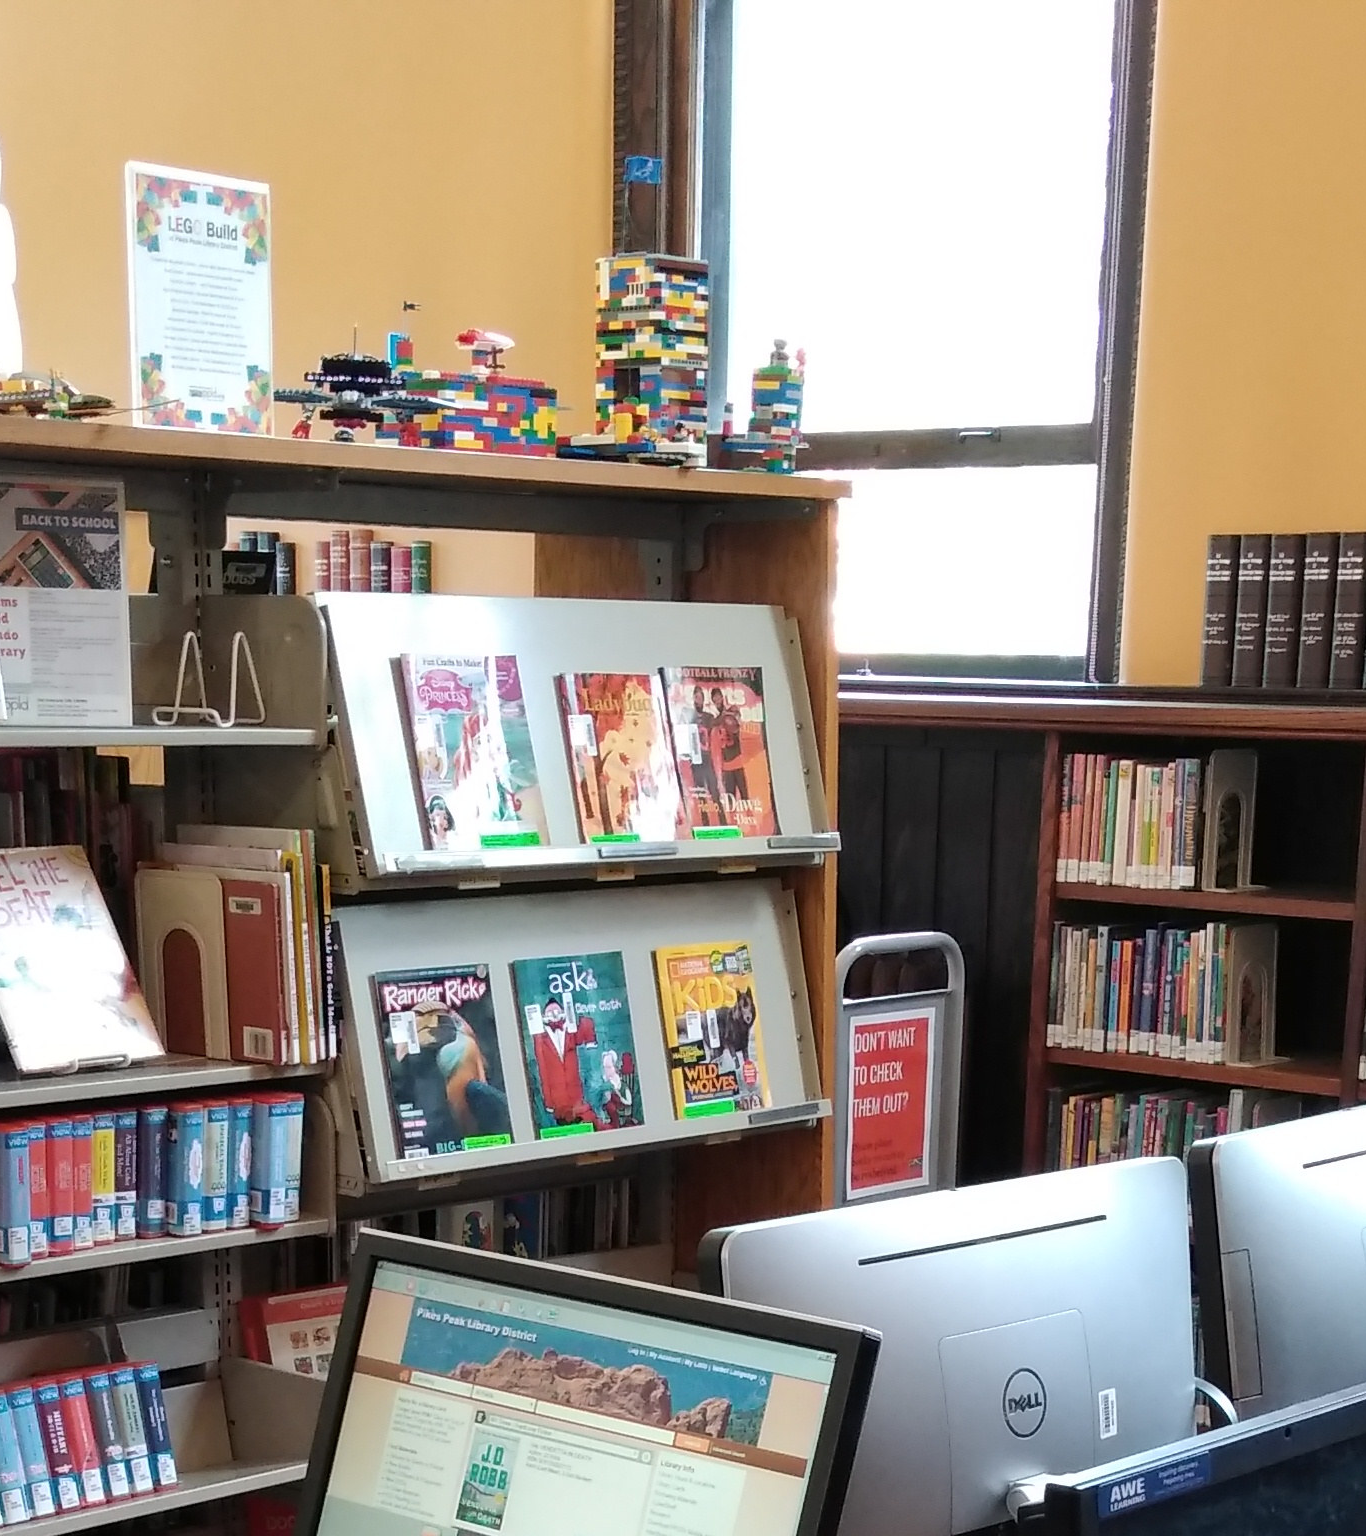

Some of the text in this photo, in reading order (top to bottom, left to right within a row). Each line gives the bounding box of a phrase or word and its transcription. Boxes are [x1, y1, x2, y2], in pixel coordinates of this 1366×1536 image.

[169, 216, 238, 241] LEGO Build
[22, 513, 117, 529] BACK TO SCHOOL
[719, 667, 758, 681] FRENZY
[419, 685, 469, 707] PRINCESS
[720, 793, 763, 813] Dawg
[21, 857, 68, 885] THE
[548, 961, 588, 994] ask
[383, 977, 479, 1013] Ranger Rick
[854, 1026, 916, 1053] DON'T WANT
[685, 1064, 718, 1080] WILD
[854, 1060, 904, 1086] TO CHECK
[853, 1091, 910, 1119] THEM OUT?
[416, 1307, 537, 1343] Pikes Peak Library District
[1007, 1391, 1043, 1415] DELL
[481, 1444, 504, 1466] J.D.
[469, 1463, 509, 1489] ROBB
[1110, 1477, 1146, 1503] AWE
[1110, 1493, 1146, 1513] LEARNING
